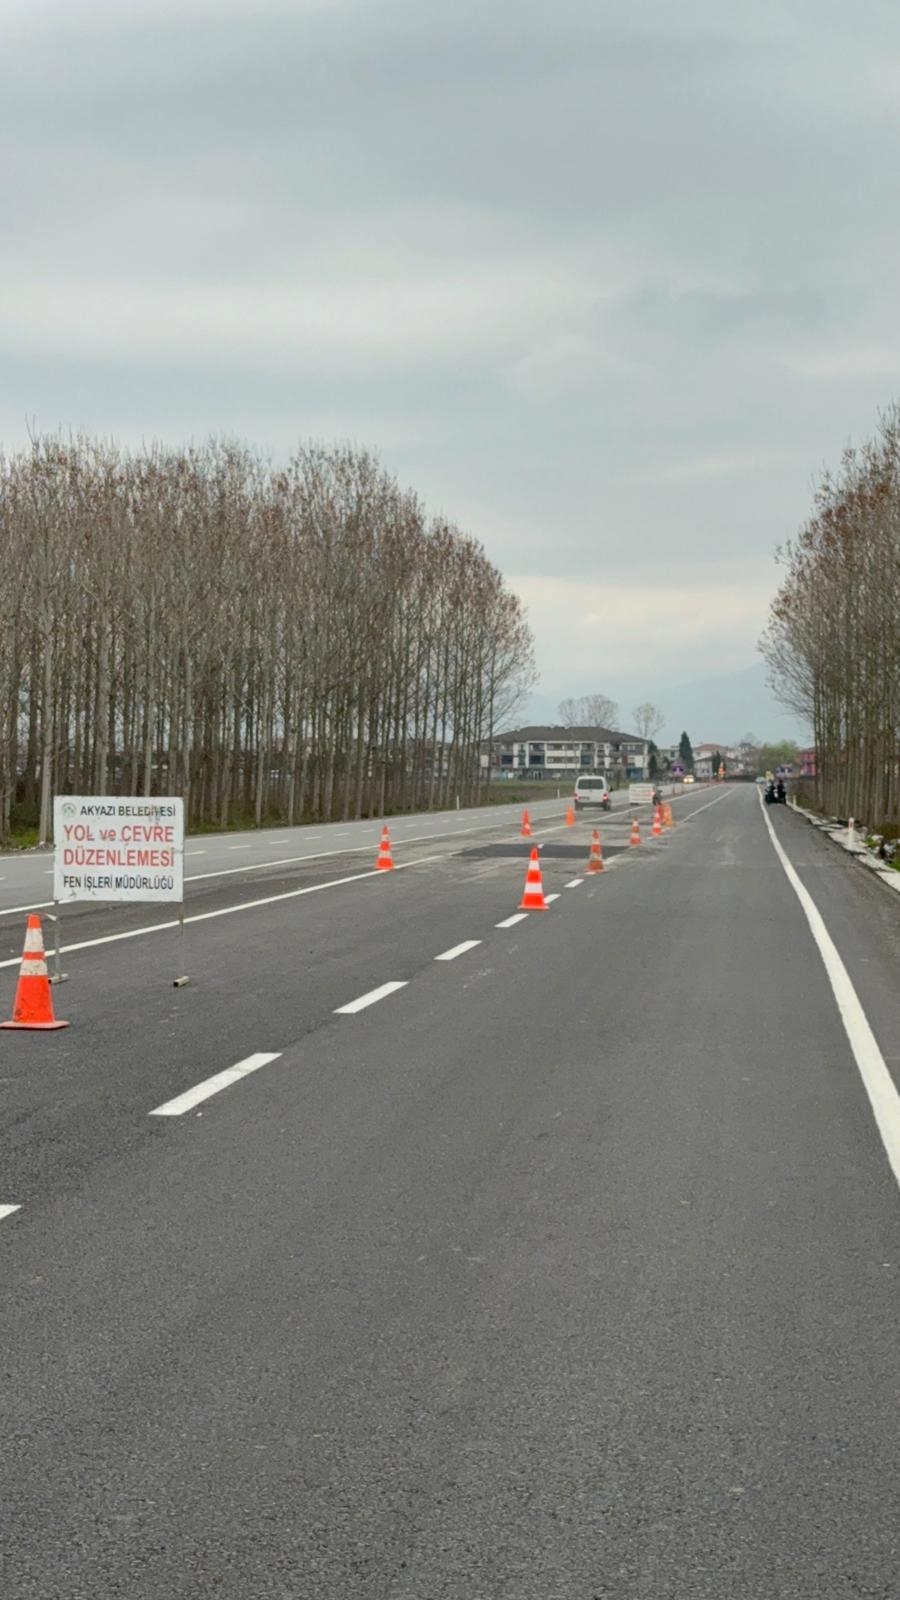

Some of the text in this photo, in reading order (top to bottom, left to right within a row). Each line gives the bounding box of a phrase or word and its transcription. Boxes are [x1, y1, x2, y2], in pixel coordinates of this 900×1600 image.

[80, 806, 116, 816] AKYAZI
[63, 824, 175, 846] YOL ve ÇEVRE
[63, 846, 175, 867] DÜZENLEMESİ
[63, 874, 174, 891] FEN İŞLERİ MÜDÜRLÜĞÜ
